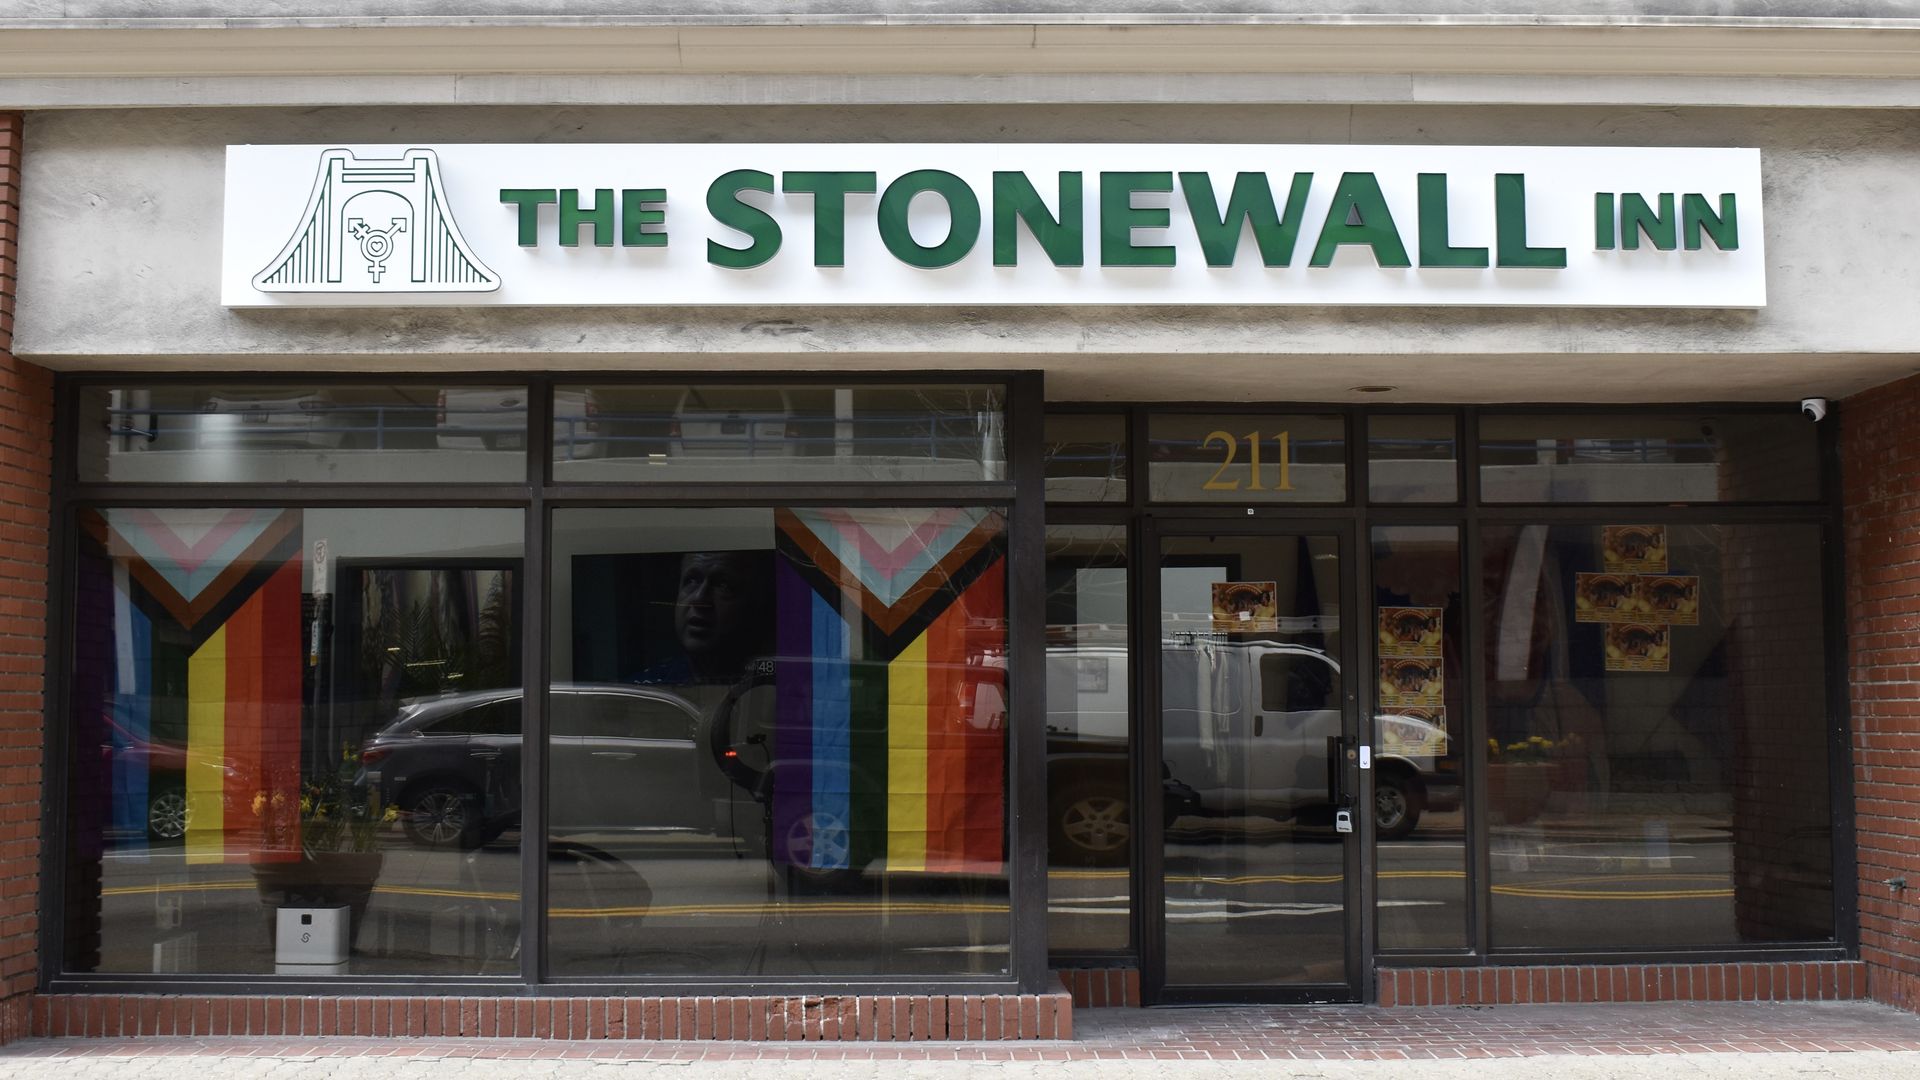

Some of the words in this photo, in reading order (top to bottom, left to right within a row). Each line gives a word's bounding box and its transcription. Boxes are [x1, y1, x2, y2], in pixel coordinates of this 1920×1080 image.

[499, 188, 669, 247] THE
[706, 169, 1568, 268] STONEWALL
[1595, 191, 1740, 251] INN
[1202, 430, 1297, 491] 211
